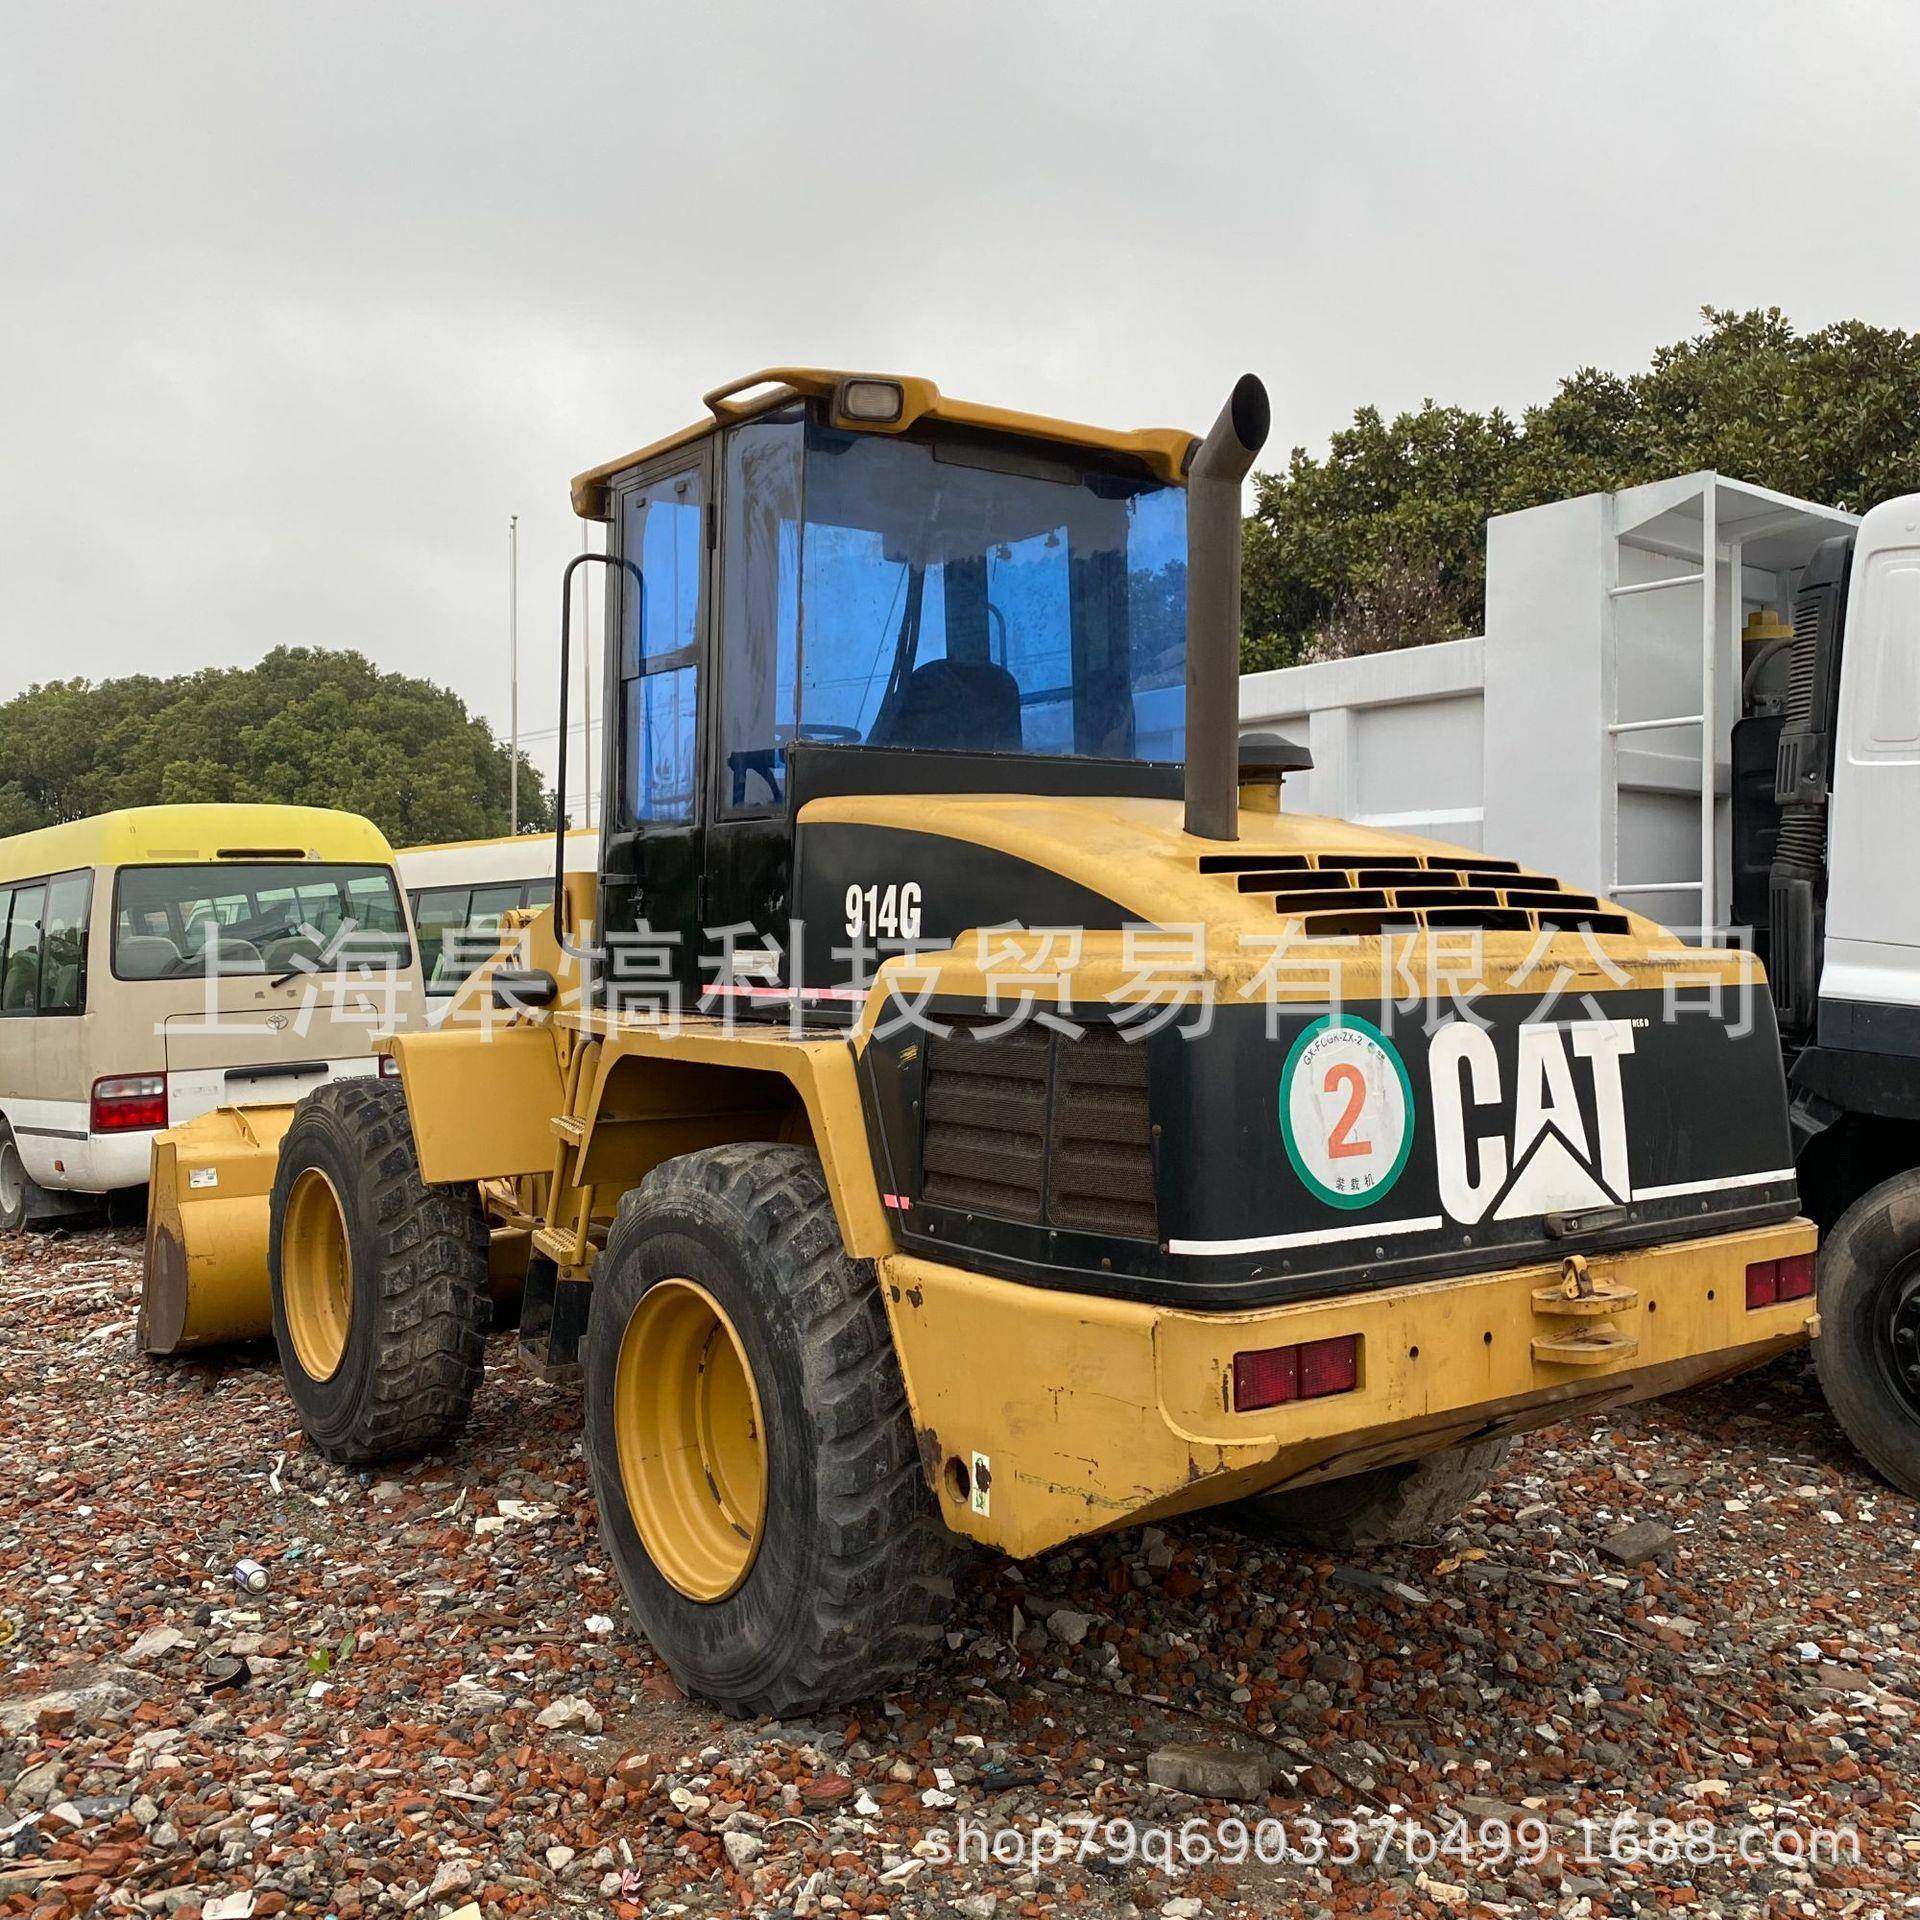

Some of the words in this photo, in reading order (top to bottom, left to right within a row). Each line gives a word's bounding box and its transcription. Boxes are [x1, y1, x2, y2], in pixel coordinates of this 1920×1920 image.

[845, 881, 922, 939] 914G
[1323, 1063, 1373, 1159] 2
[1428, 1019, 1636, 1225] CAT
